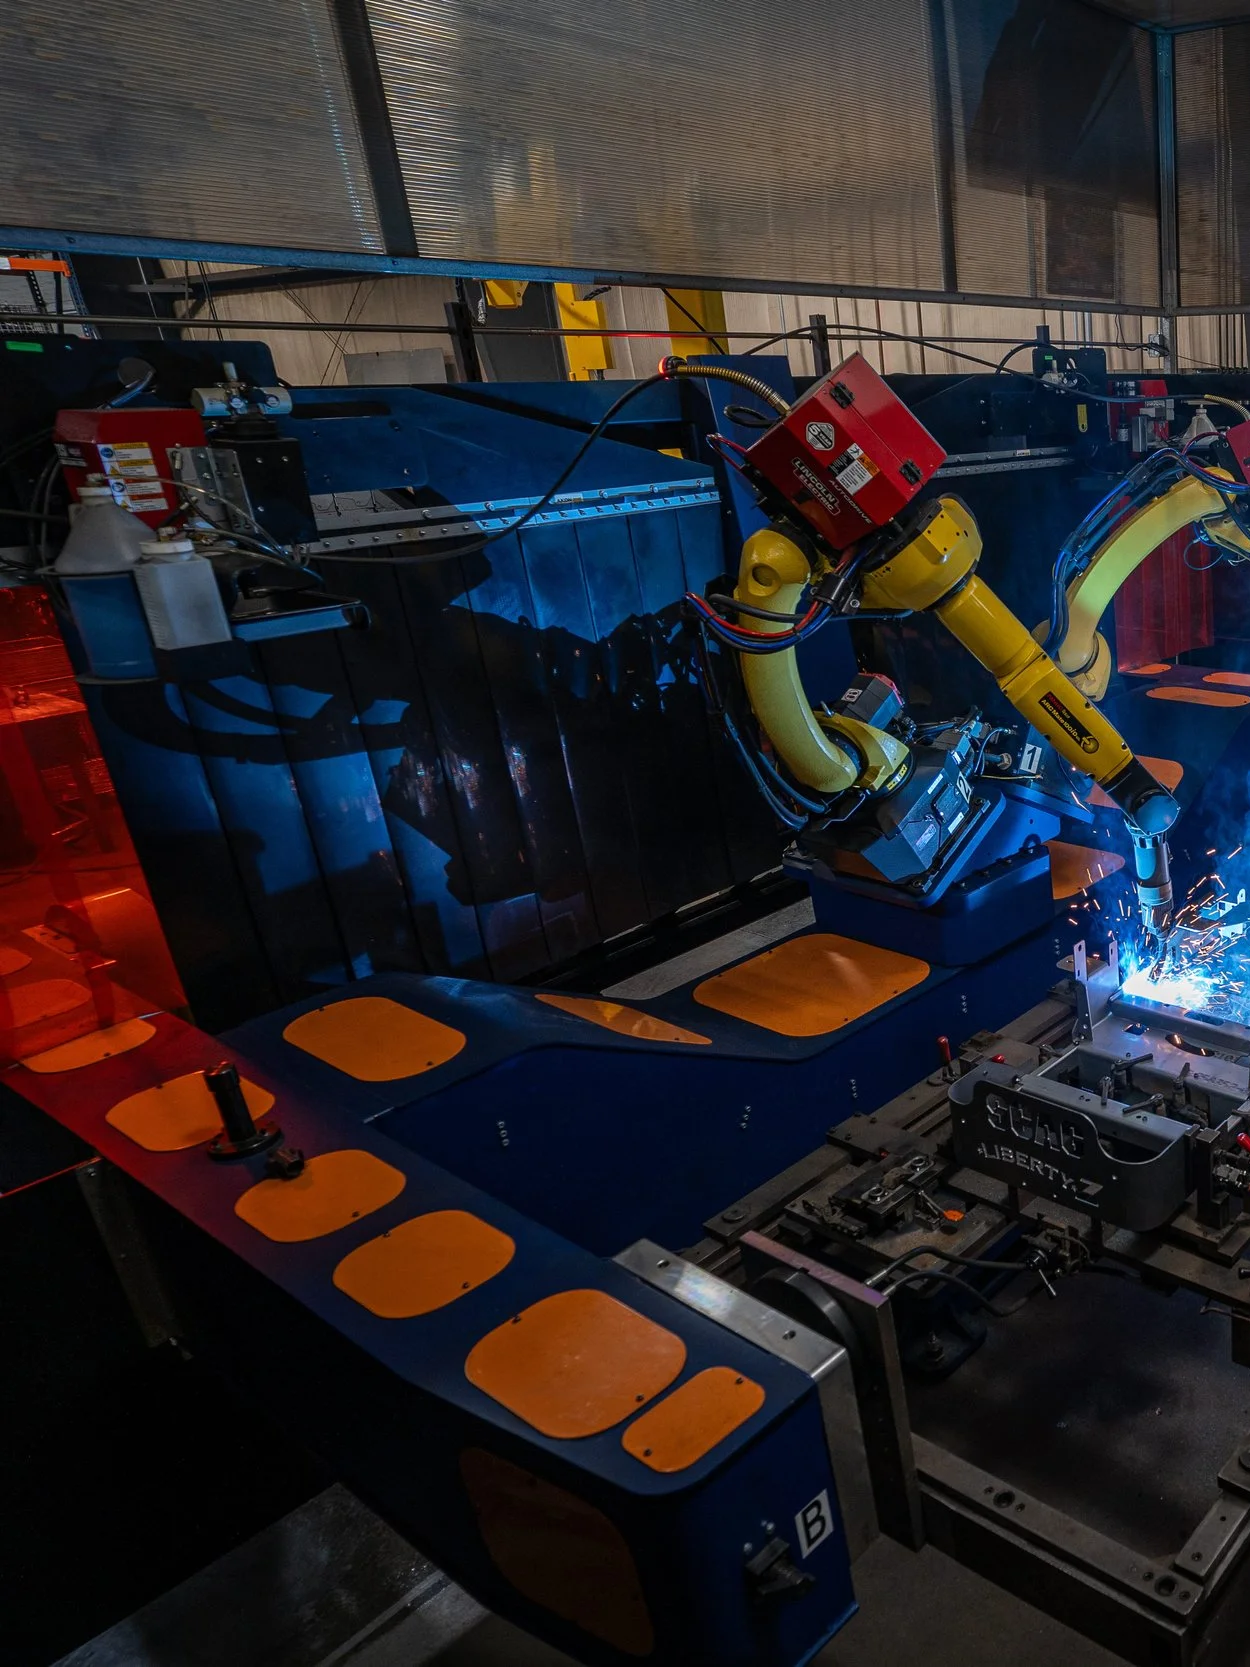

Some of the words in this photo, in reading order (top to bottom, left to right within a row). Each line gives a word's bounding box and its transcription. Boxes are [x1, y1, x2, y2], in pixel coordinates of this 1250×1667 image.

[809, 424, 821, 435] 5
[795, 460, 835, 502] LINCOLN
[799, 474, 834, 511] ELECTRIC
[829, 479, 871, 524] AUTODRIVE
[1041, 699, 1054, 712] ARC
[1027, 746, 1037, 770] 1
[959, 776, 970, 799] 2
[986, 1093, 1085, 1160] SCAG
[979, 1142, 1075, 1190] LIBERTY
[1074, 1177, 1103, 1208] Z
[801, 1499, 826, 1549] B
